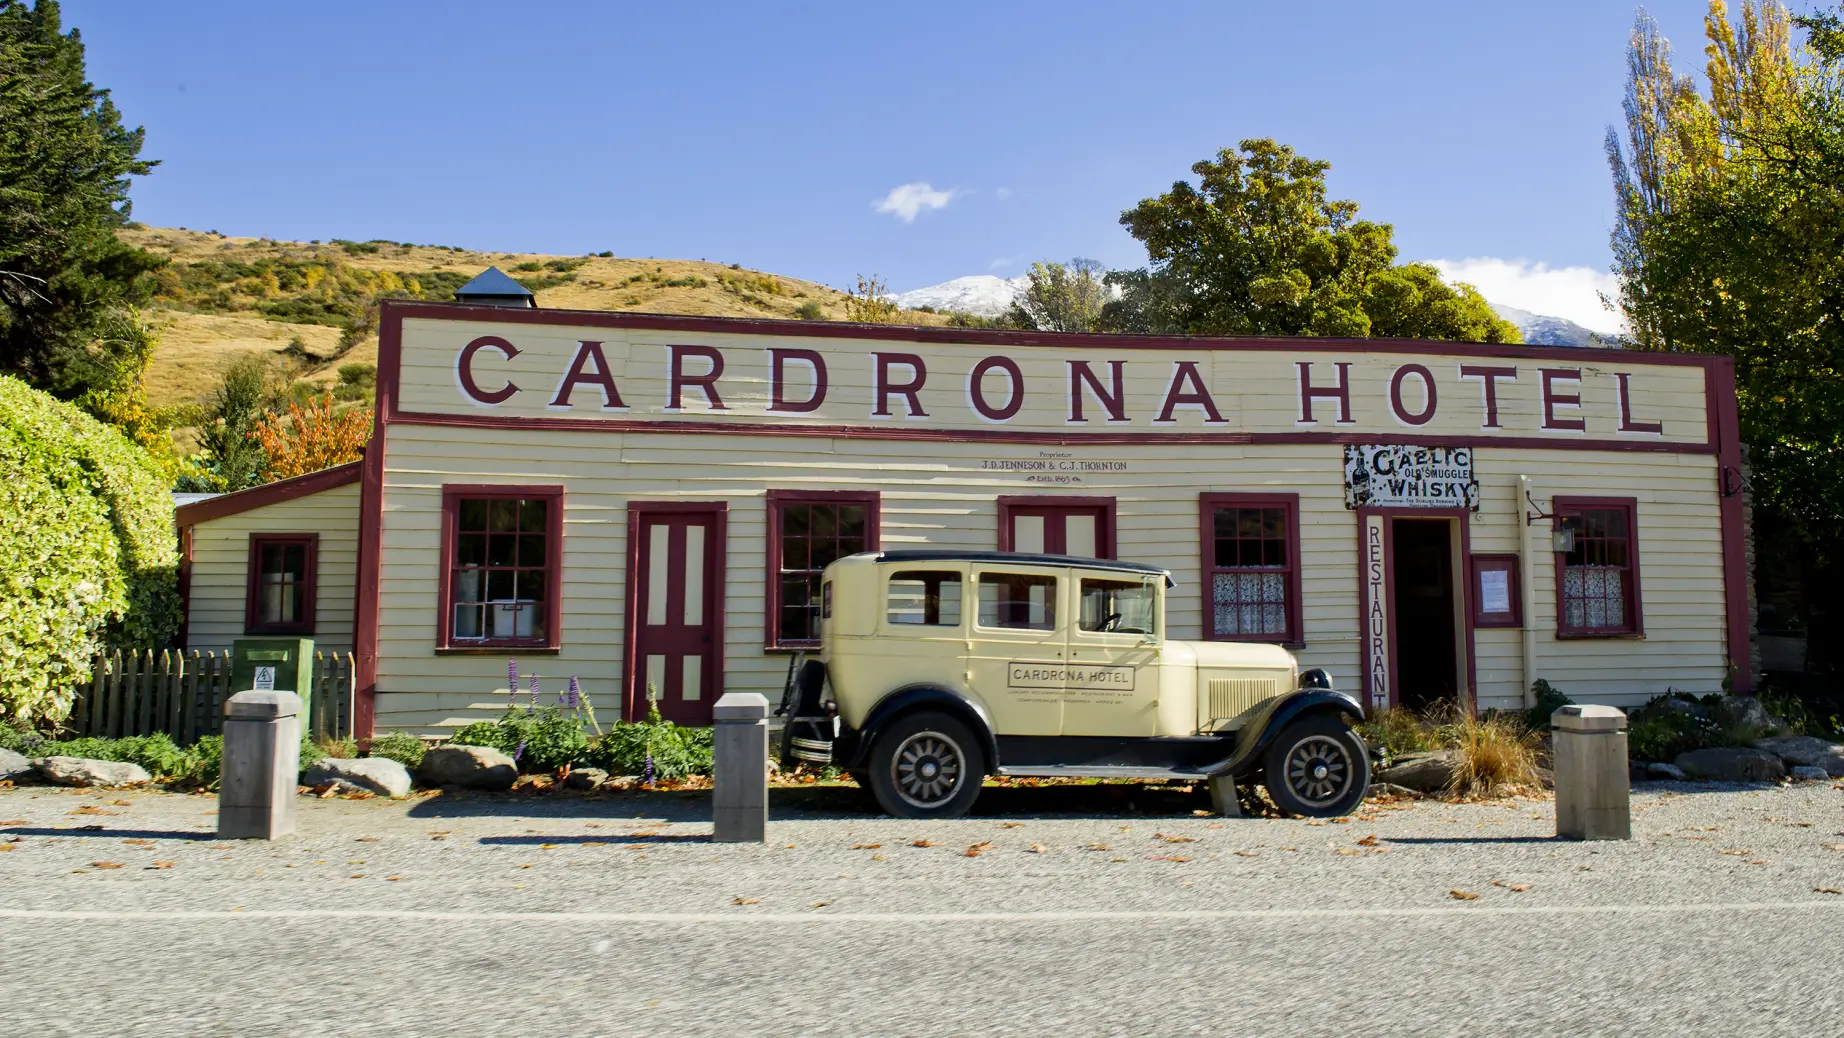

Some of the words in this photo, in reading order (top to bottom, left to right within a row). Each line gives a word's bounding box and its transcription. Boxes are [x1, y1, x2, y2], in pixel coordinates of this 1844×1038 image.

[456, 336, 1229, 423] CARDRONA
[1295, 362, 1663, 435] HOTEL
[1049, 461, 1055, 470] &
[1373, 449, 1469, 475] GAELIC
[1387, 479, 1471, 497] WHISKY
[1369, 526, 1386, 708] RESTAURANT
[1013, 669, 1084, 681] CARDRONA
[1089, 671, 1129, 683] HOTEL
